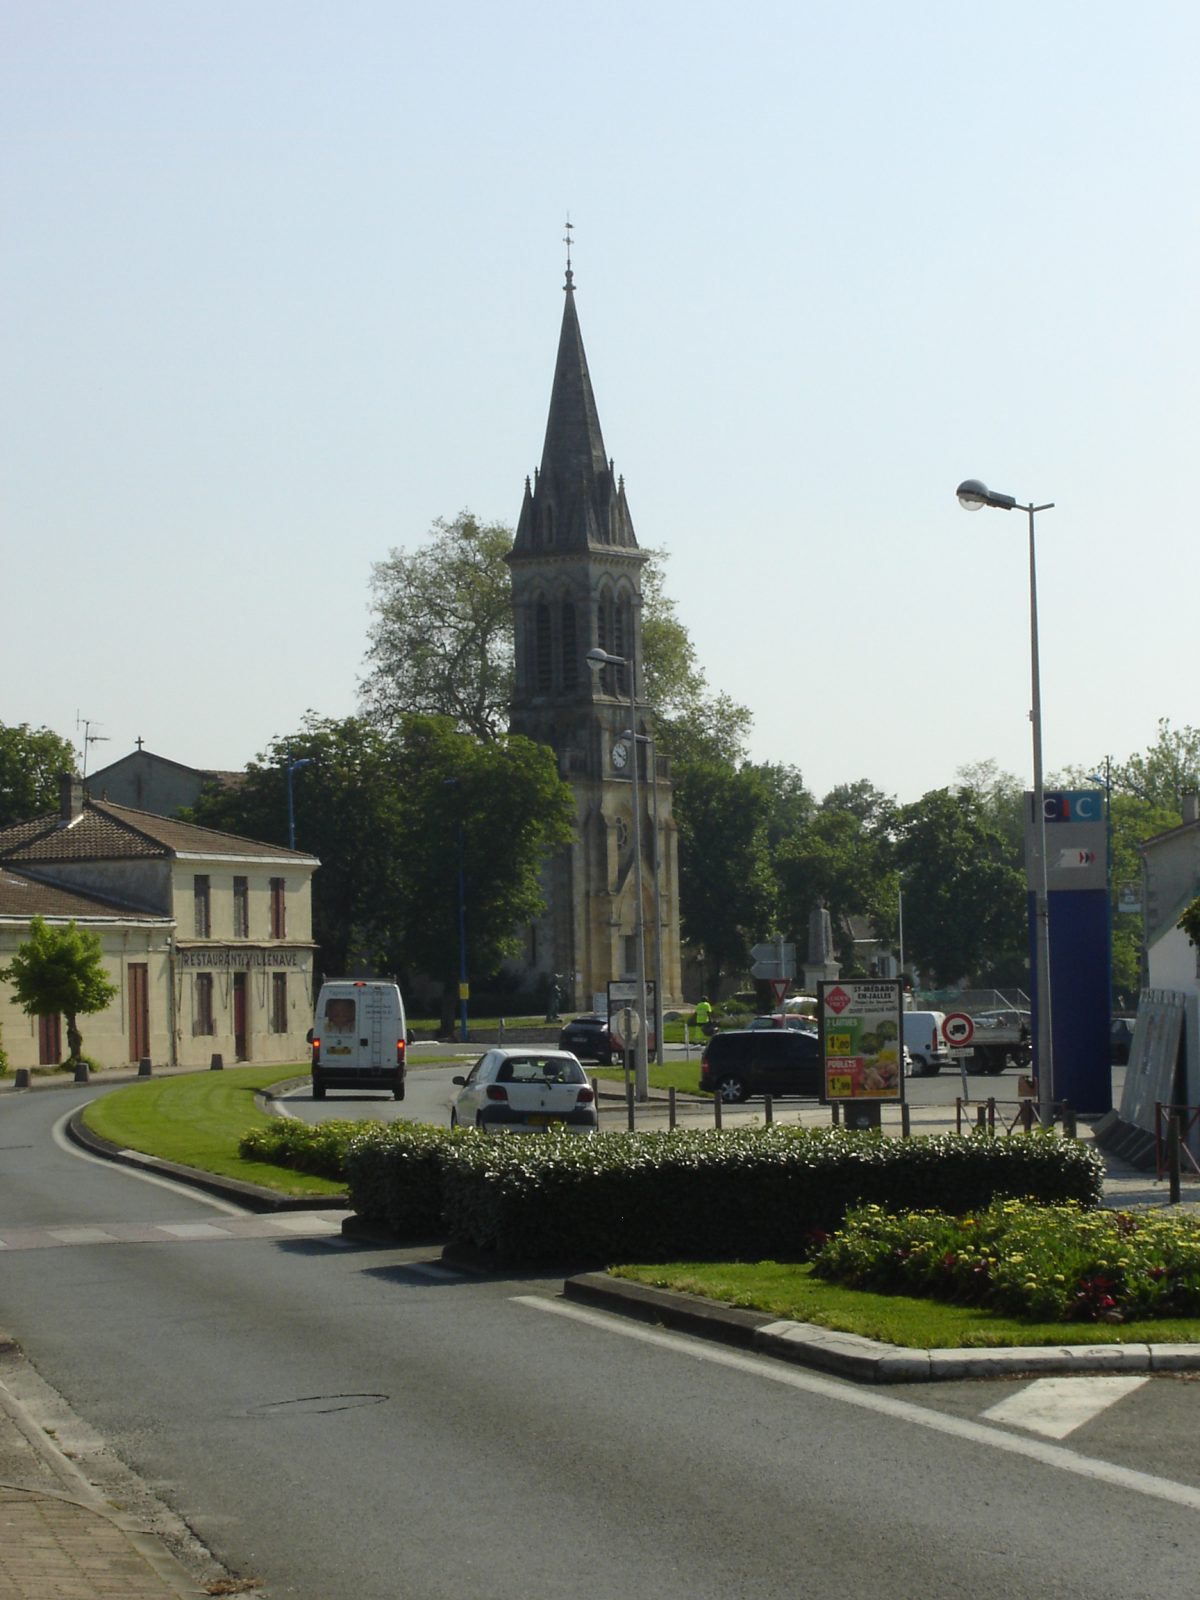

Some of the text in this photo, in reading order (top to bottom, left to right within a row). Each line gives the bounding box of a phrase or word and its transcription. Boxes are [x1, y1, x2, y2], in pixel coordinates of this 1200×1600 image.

[1043, 798, 1092, 818] CIC
[184, 952, 297, 967] RESTAURANT VILLENAVE
[827, 1059, 857, 1068] POULETS
